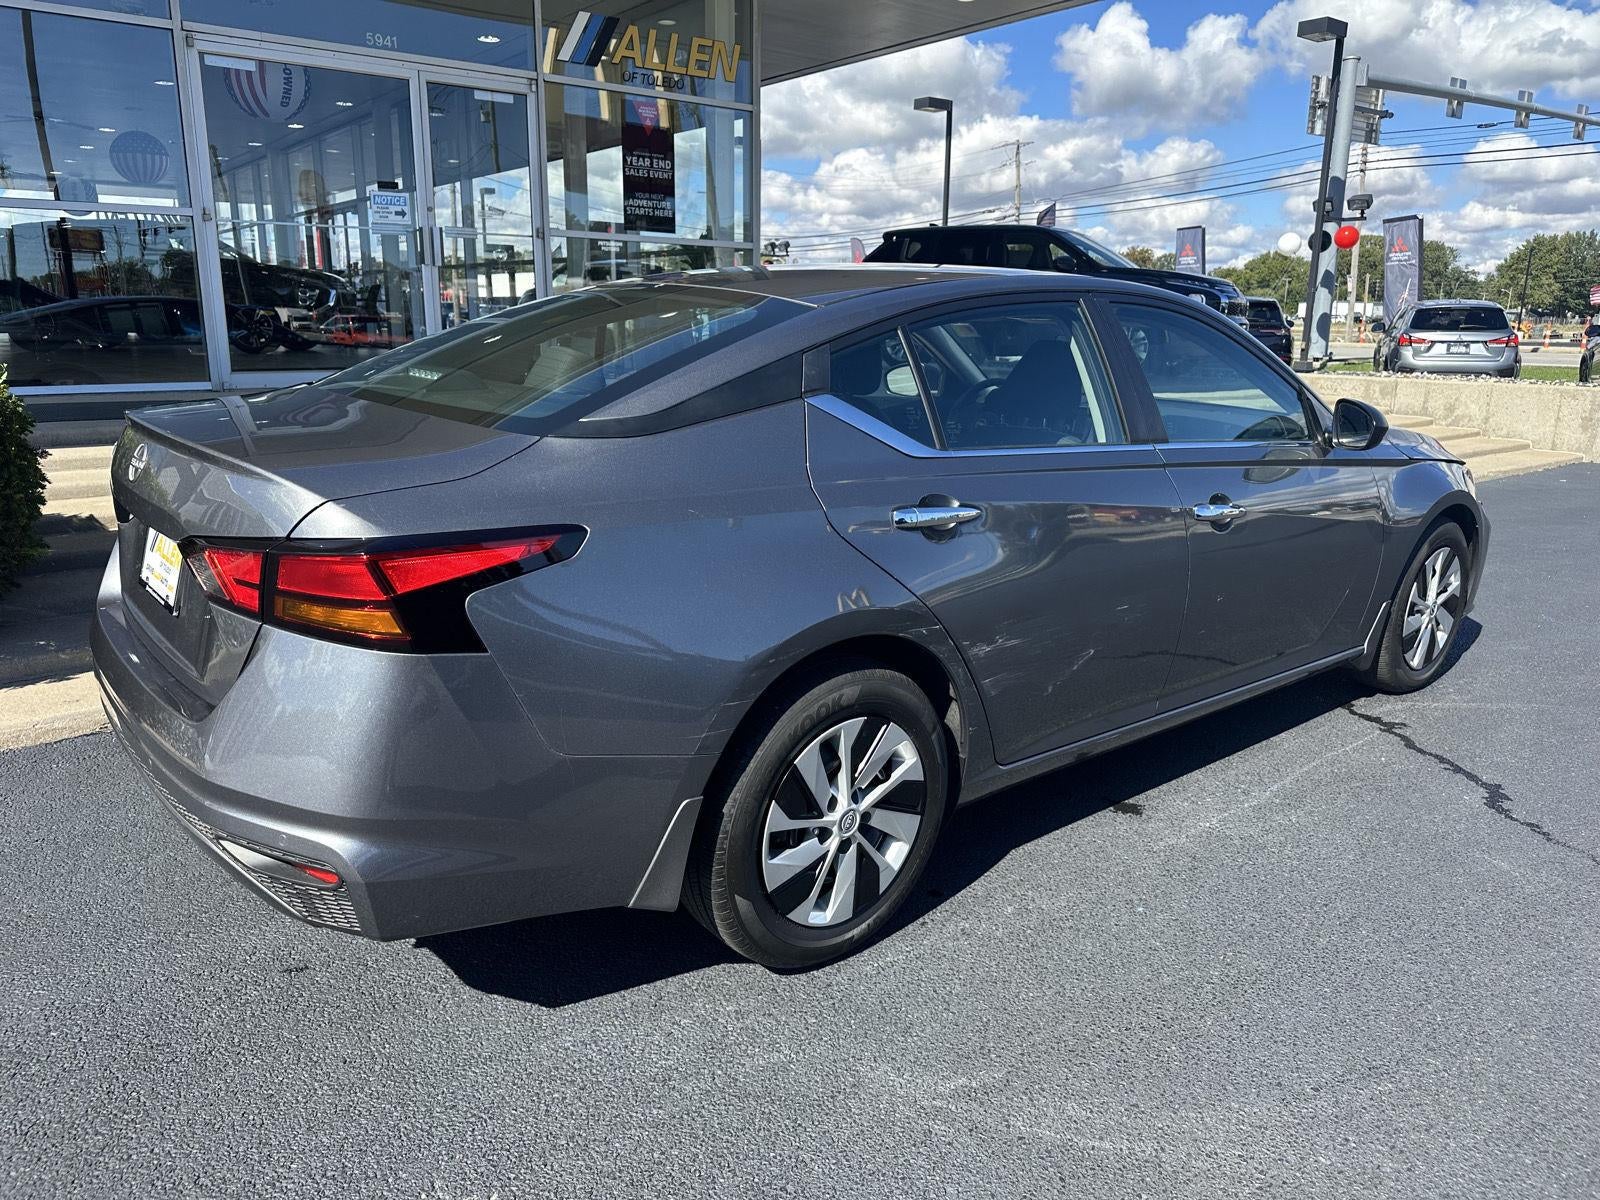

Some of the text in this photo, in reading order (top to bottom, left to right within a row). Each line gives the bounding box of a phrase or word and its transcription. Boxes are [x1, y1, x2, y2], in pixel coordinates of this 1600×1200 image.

[366, 32, 398, 49] 5941
[611, 24, 741, 83] ALLEN
[622, 71, 685, 90] OF TOLEDO
[625, 156, 672, 170] YEAR END
[624, 167, 673, 180] SALES EVENT
[374, 195, 406, 206] NOTICE
[626, 207, 673, 218] STARTS HERE
